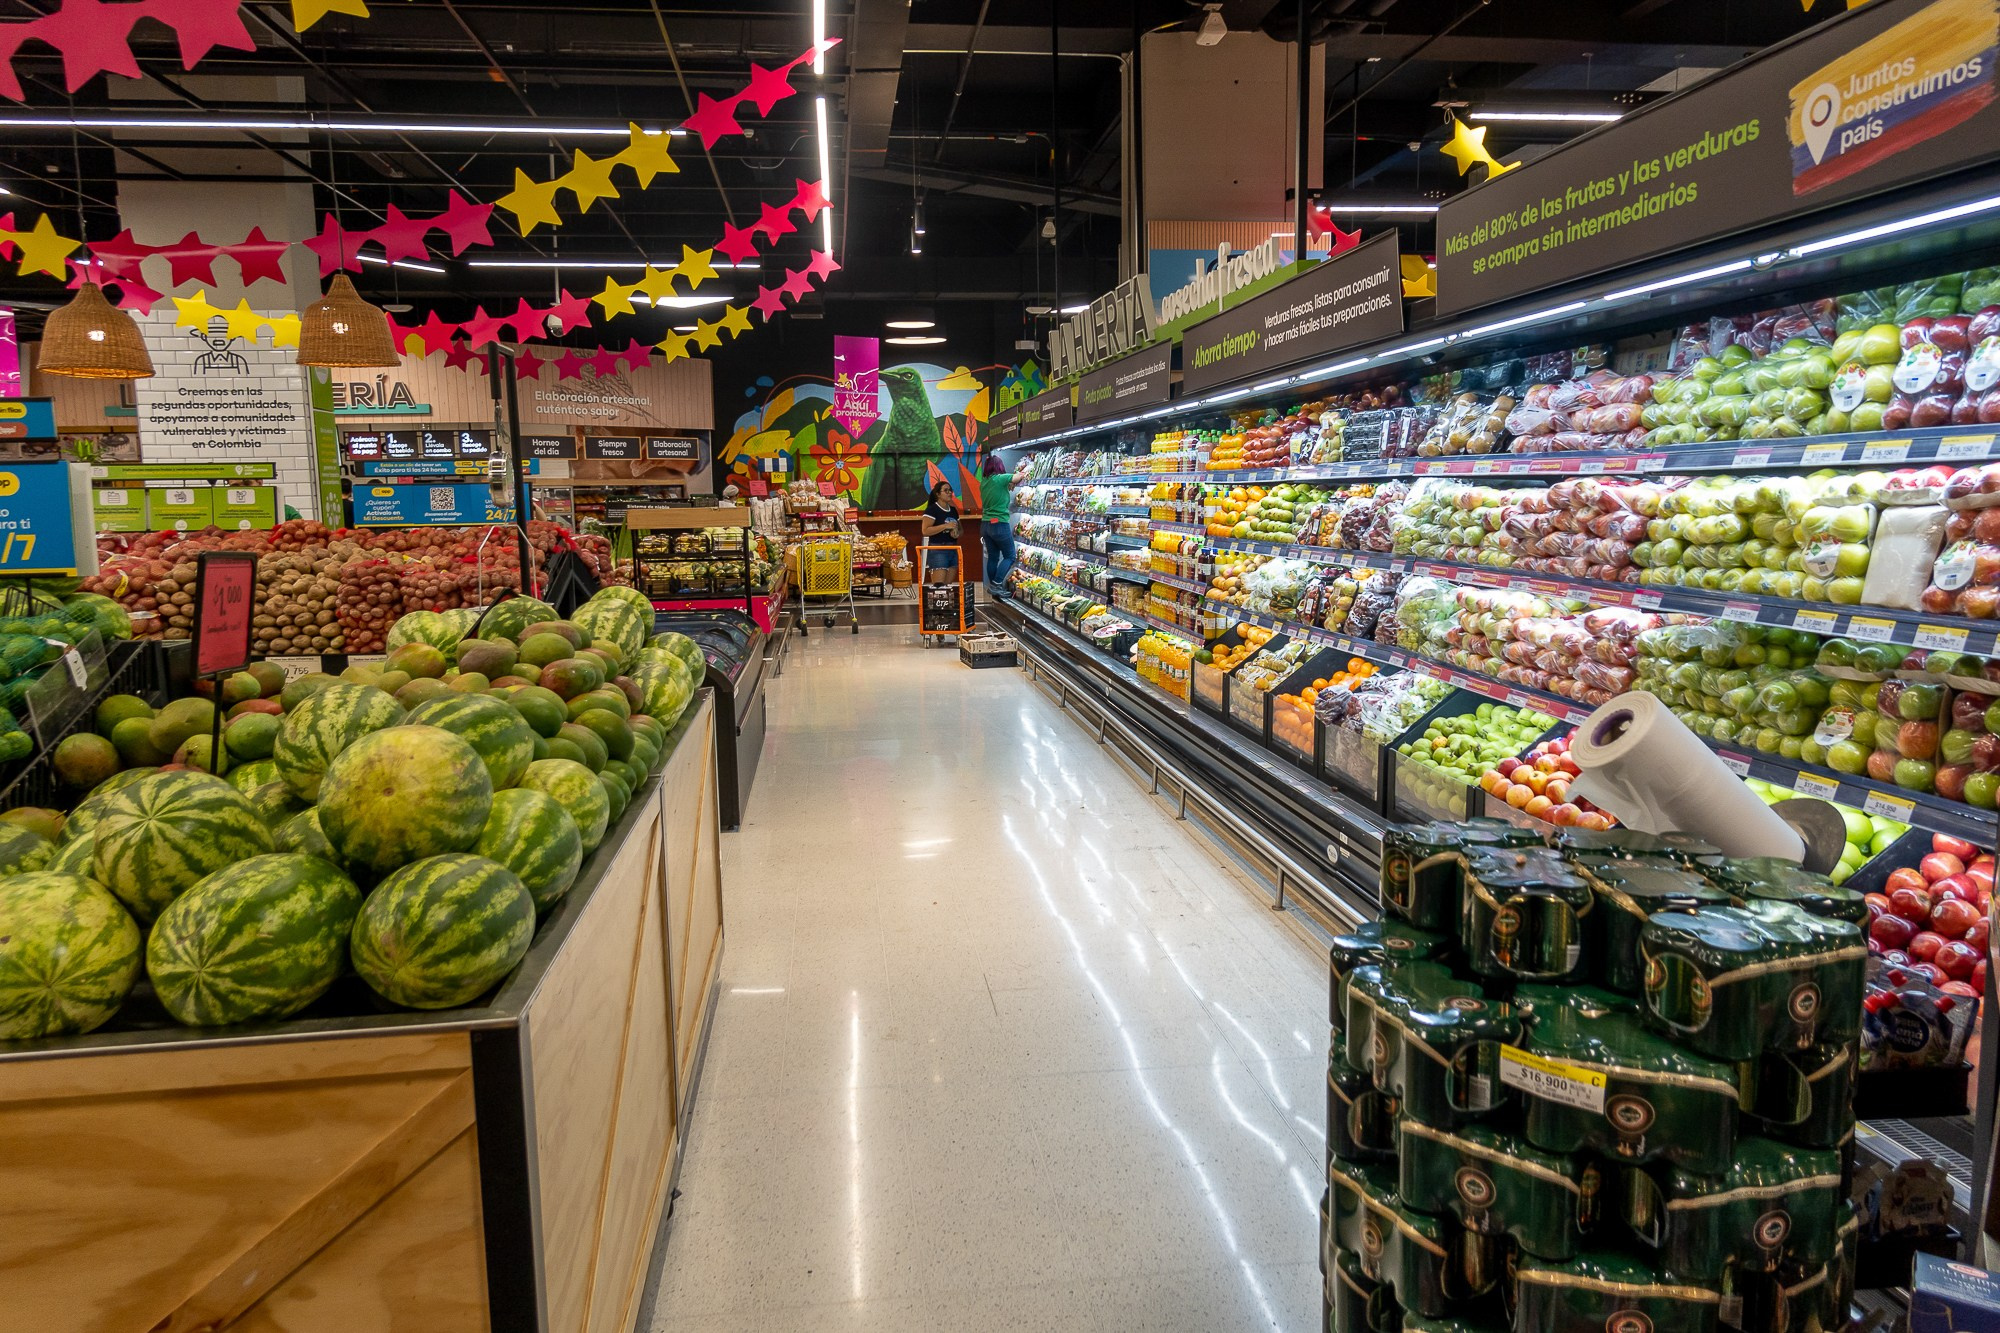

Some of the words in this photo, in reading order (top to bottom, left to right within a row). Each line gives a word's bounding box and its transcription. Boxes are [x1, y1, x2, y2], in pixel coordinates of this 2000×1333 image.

[1843, 57, 1916, 99] Juntos
[1842, 57, 1982, 123] construimos
[1840, 116, 1883, 154] país
[1445, 232, 1469, 256] Más
[1471, 221, 1489, 246] del
[1490, 210, 1518, 239] 80%
[1520, 204, 1539, 227] de
[1541, 198, 1563, 220] las
[1565, 176, 1616, 210] frutas
[1618, 170, 1630, 196] y
[1633, 159, 1660, 185] las
[1664, 118, 1760, 172] verduras
[1472, 257, 1486, 275] se
[1487, 237, 1540, 265] compra
[1542, 226, 1564, 251] sin
[1567, 182, 1698, 244] intermediarios
[1161, 258, 1219, 325] cosecha
[1218, 237, 1280, 313] fresca
[1264, 311, 1290, 329] Verduras
[1290, 303, 1314, 319] frescas,
[1314, 292, 1333, 310] listas
[1333, 284, 1352, 305] para
[1352, 265, 1390, 295] consumir
[1049, 322, 1073, 382] LA
[1071, 273, 1155, 371] HUERTA
[1263, 337, 1268, 351] y
[1268, 331, 1286, 347] hacer
[1285, 324, 1299, 341] más
[1299, 317, 1320, 337] fáciles
[1320, 314, 1332, 329] tus
[1333, 293, 1393, 327] preparaciones.
[178, 387, 229, 396] Creemos
[231, 388, 244, 396] en
[247, 387, 263, 396] las
[535, 391, 600, 404] Elaboración
[601, 394, 653, 407] artesanal,
[151, 401, 206, 411] segundas
[207, 400, 292, 410] oportunidades,
[536, 404, 589, 415] auténtico
[590, 406, 620, 417] sabor
[843, 400, 870, 412] Aquí
[150, 415, 209, 424] apoyamos
[221, 413, 296, 422] comunidades
[835, 409, 878, 418] promoción
[161, 427, 227, 435] vulnerables
[229, 428, 236, 437] y
[238, 426, 287, 435] víctimas
[387, 433, 397, 443] 1.
[424, 433, 436, 443] 2.
[461, 432, 474, 443] 3.
[532, 439, 560, 447] Horneo
[192, 441, 206, 449] en
[207, 439, 262, 449] Colombia
[598, 440, 627, 449] Siempre
[653, 440, 692, 449] Elaboración
[534, 447, 546, 455] del
[657, 449, 689, 457] artesanal
[1592, 1076, 1600, 1087] C
